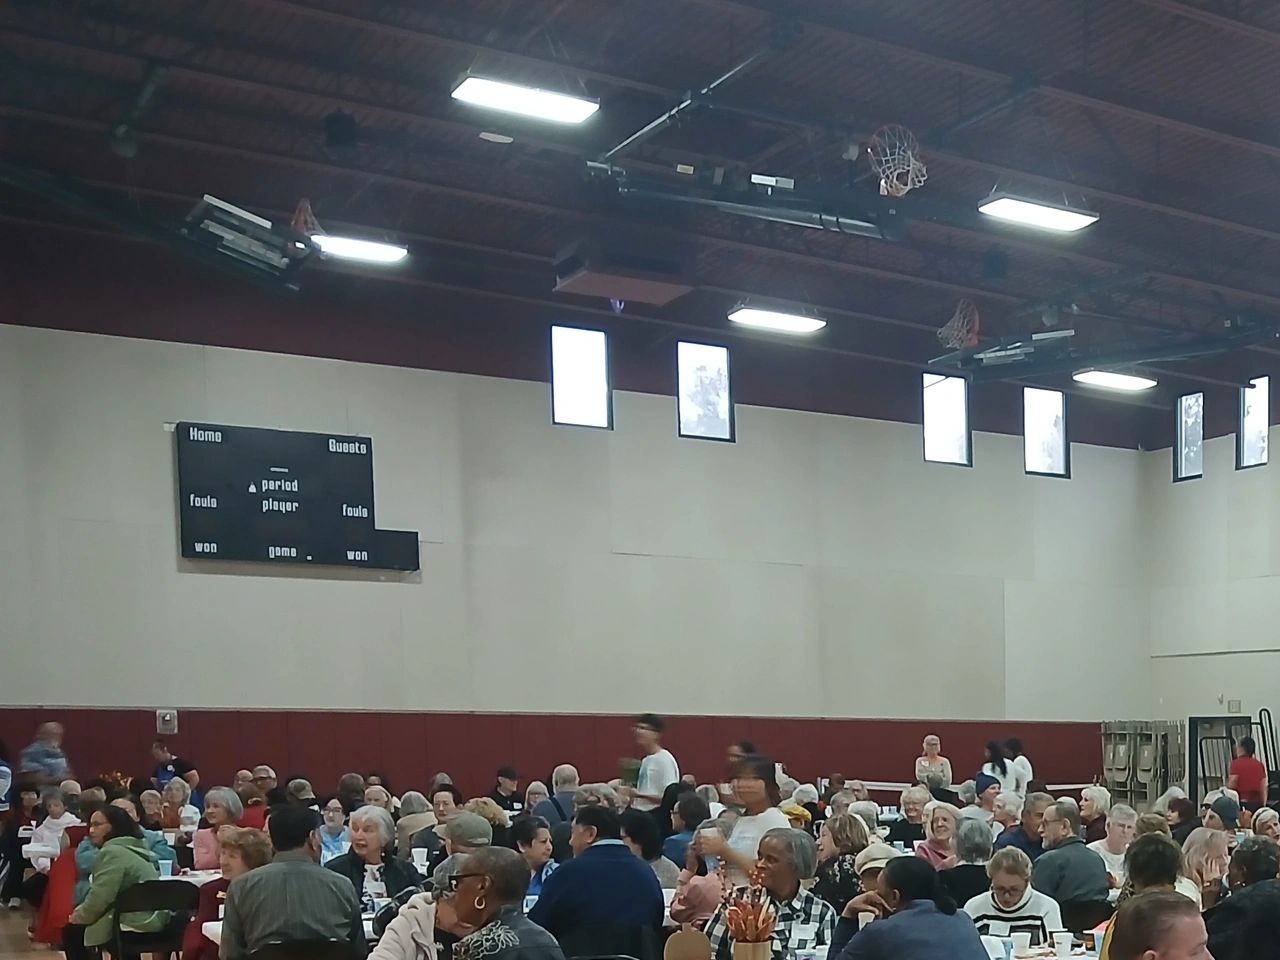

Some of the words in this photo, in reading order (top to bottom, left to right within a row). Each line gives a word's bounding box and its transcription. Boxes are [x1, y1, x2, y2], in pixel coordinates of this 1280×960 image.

[189, 427, 222, 443] Home
[261, 479, 298, 493] period
[194, 542, 217, 553] won
[346, 550, 368, 561] won
